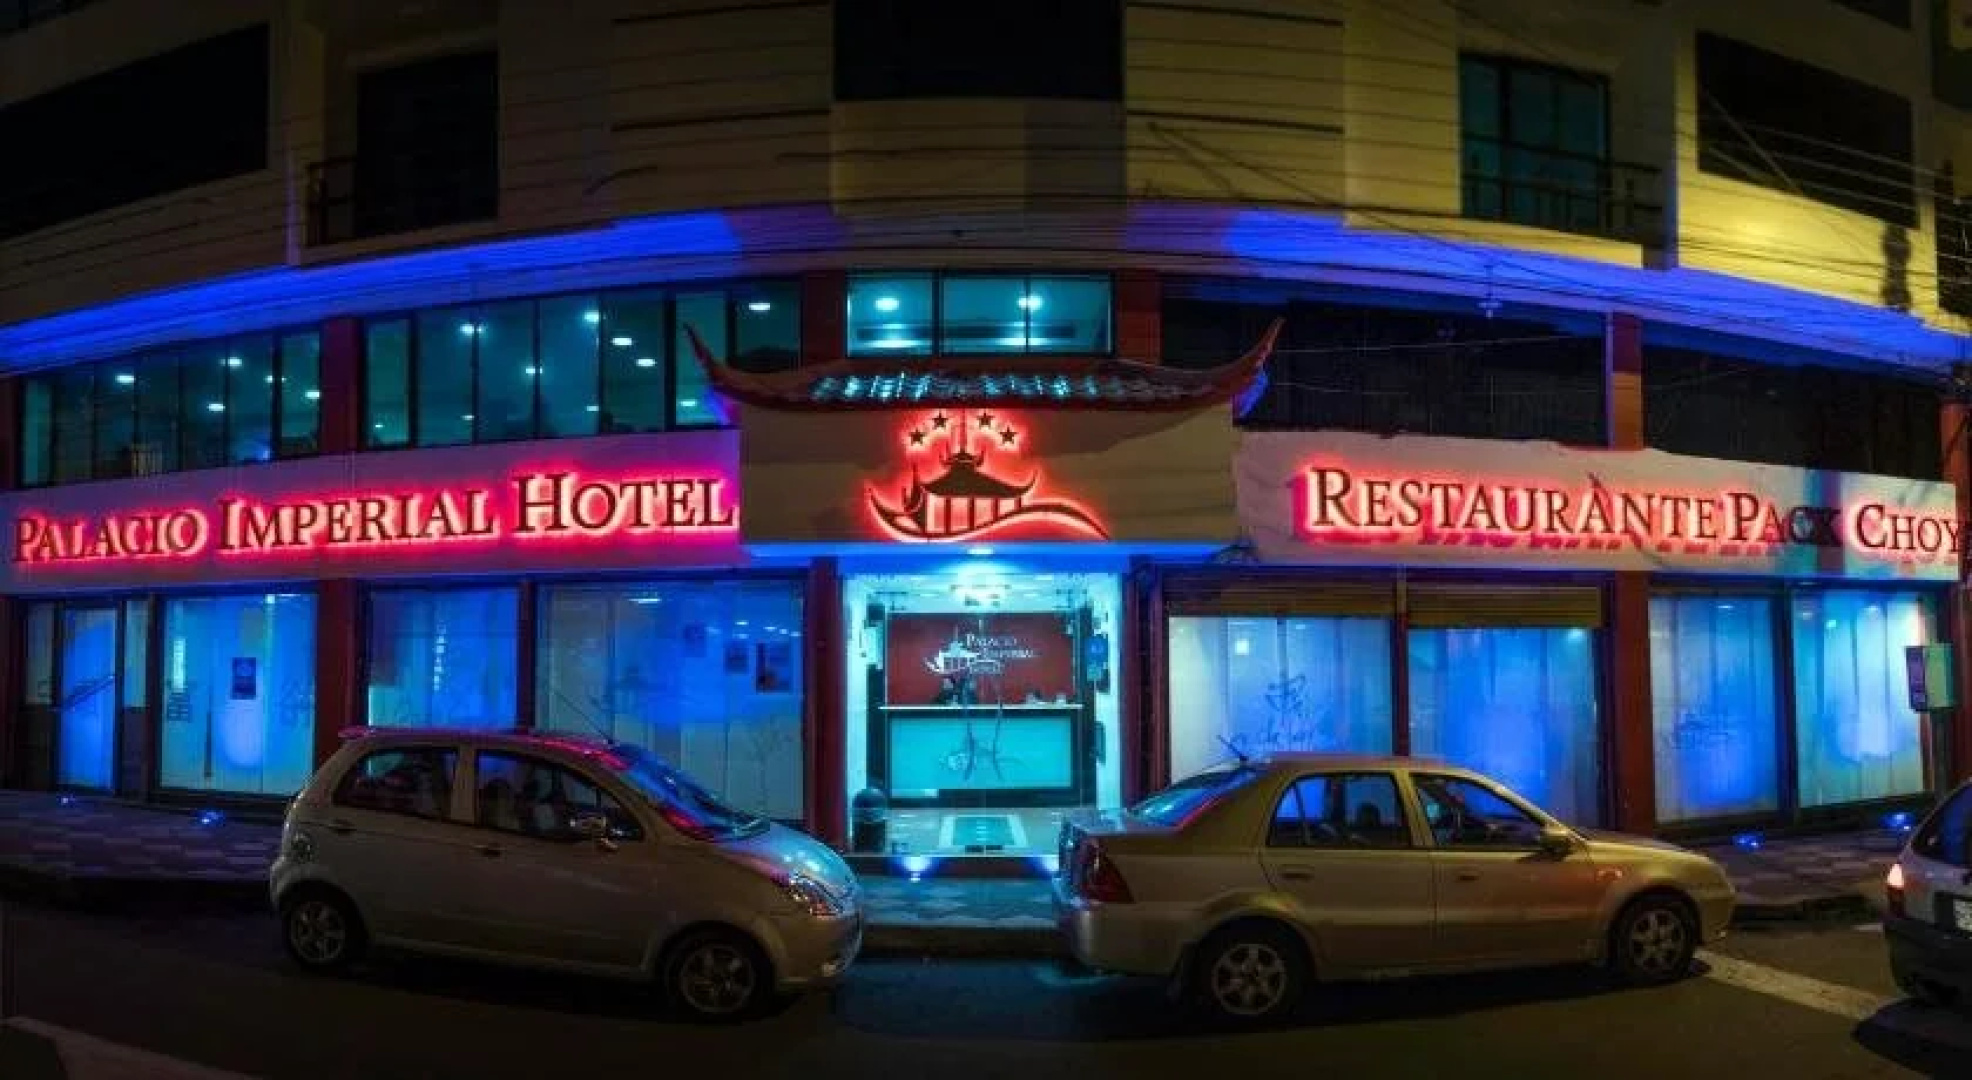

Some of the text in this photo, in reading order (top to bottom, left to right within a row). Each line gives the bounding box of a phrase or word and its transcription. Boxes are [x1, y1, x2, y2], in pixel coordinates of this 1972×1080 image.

[14, 470, 735, 562] PALACIO IMPERIAL HOTEL
[1855, 504, 1960, 552] CHOY
